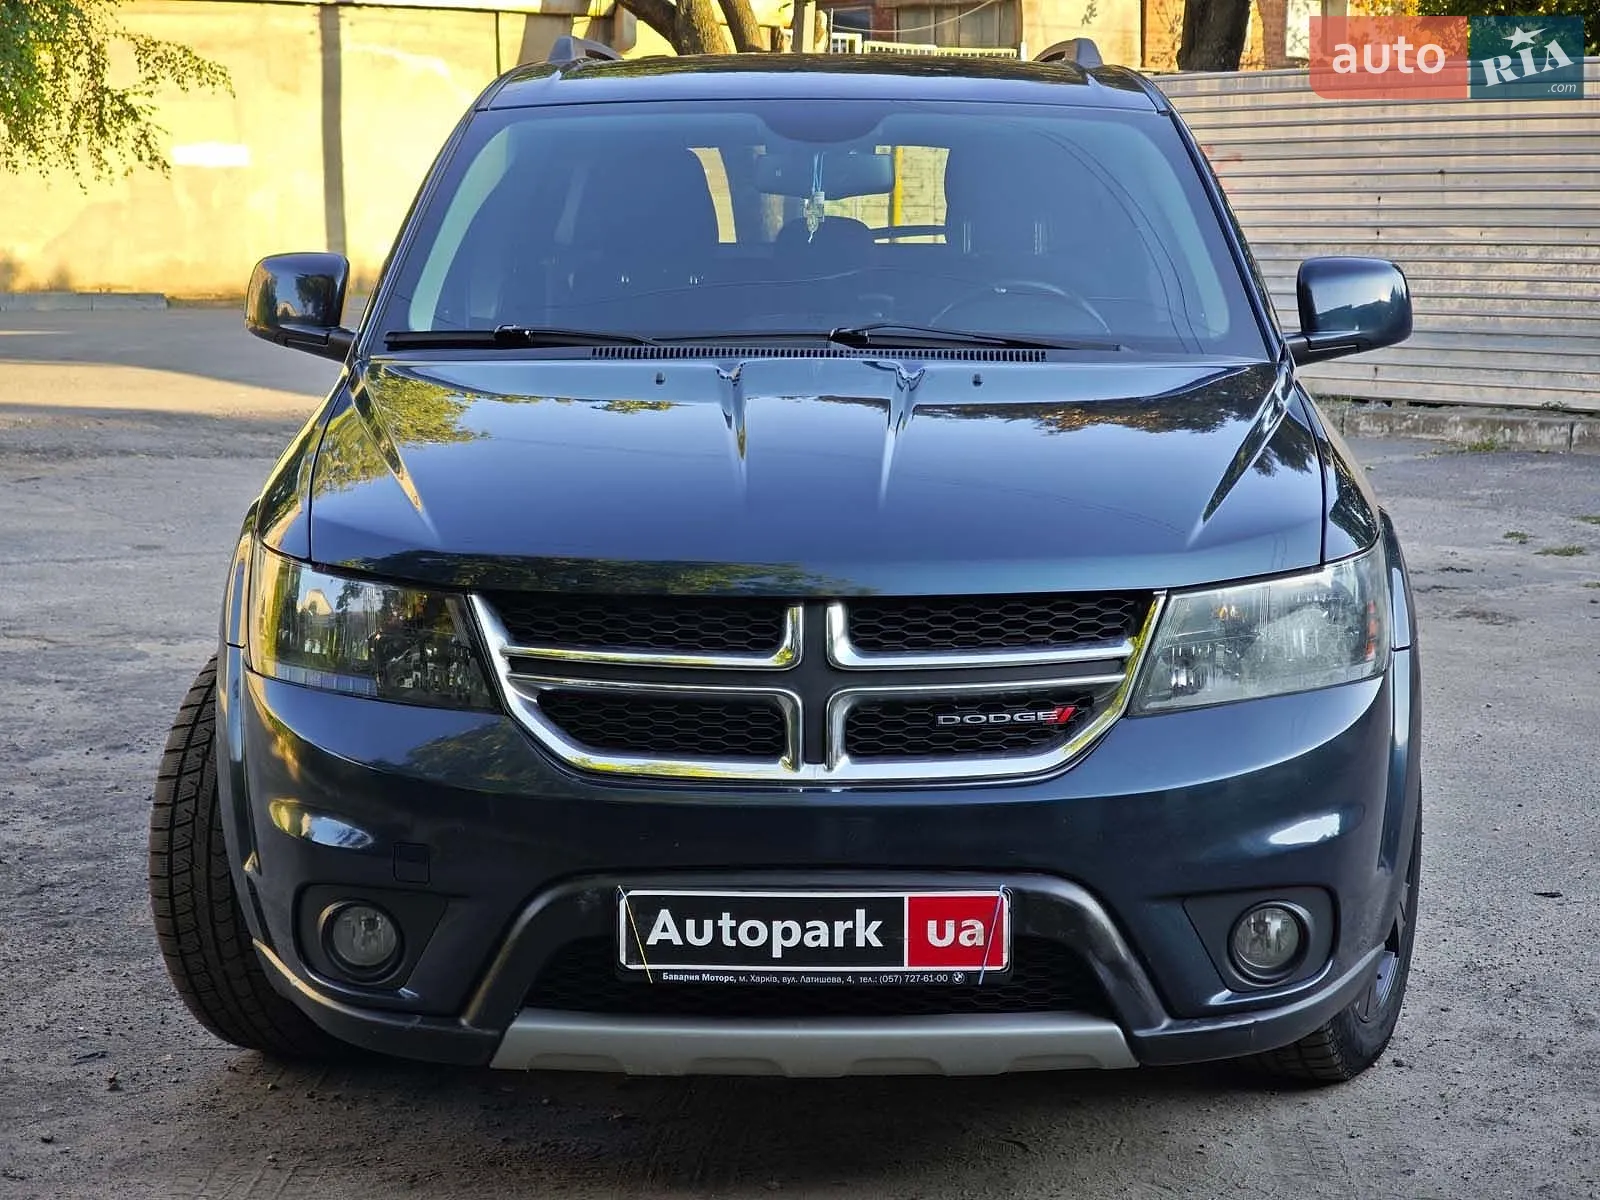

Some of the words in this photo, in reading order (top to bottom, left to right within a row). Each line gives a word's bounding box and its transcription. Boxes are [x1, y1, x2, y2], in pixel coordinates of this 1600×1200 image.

[937, 711, 1058, 725] DODGE
[645, 908, 883, 958] Autopark
[926, 918, 985, 947] ua
[879, 973, 902, 985] (057)
[904, 973, 948, 984] 727-61-00
